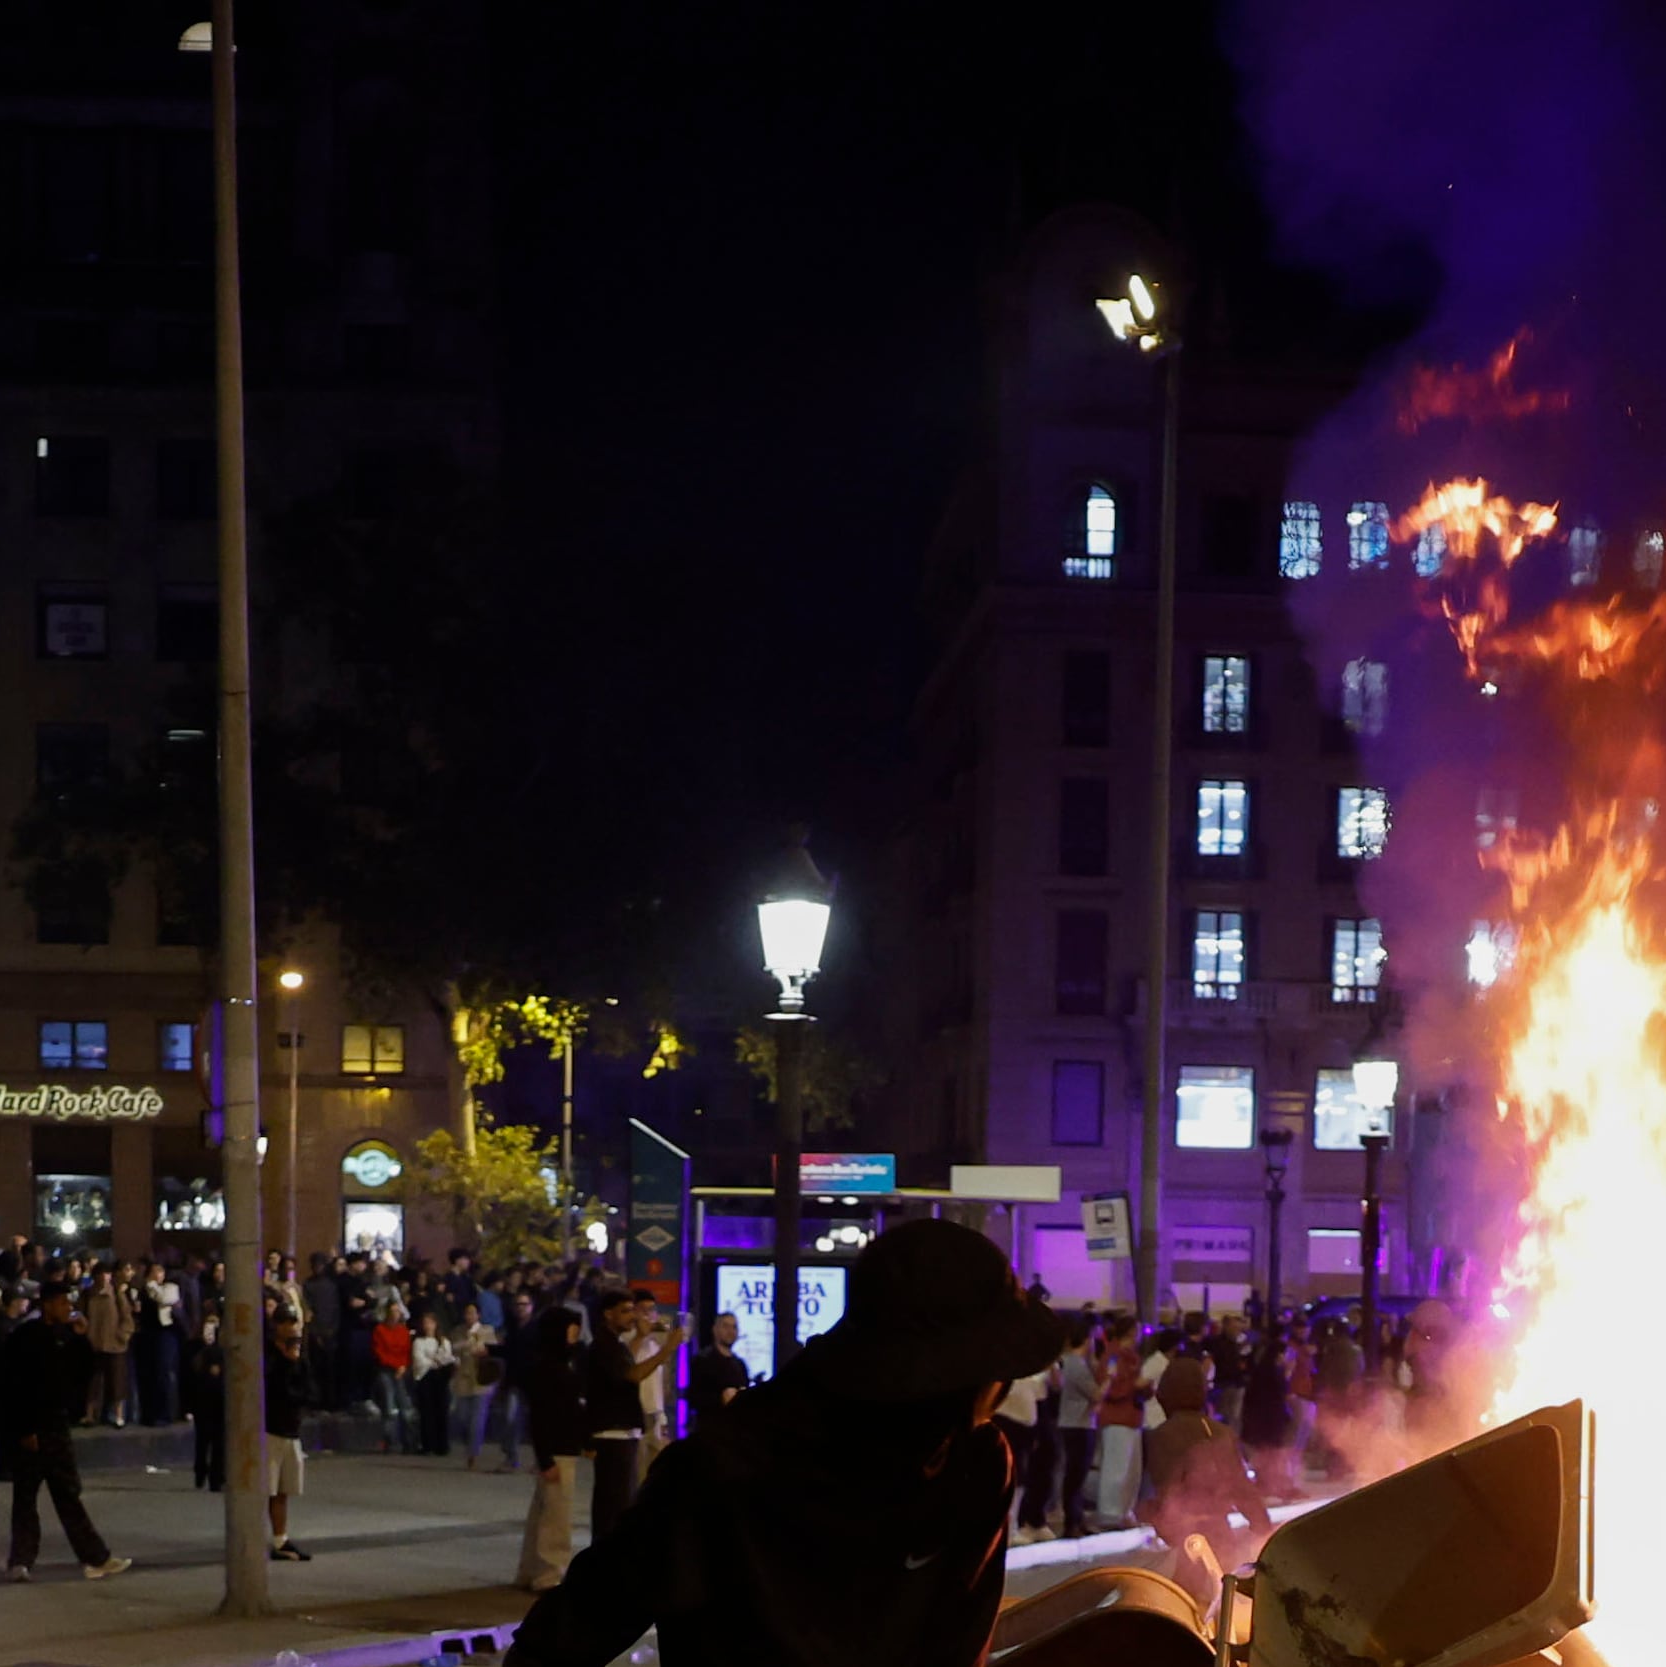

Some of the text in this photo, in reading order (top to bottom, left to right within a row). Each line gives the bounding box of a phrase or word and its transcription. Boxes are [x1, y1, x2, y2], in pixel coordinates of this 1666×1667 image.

[47, 1085, 107, 1121] Rock
[106, 1085, 163, 1121] Cafe
[738, 1280, 827, 1299] ARBA
